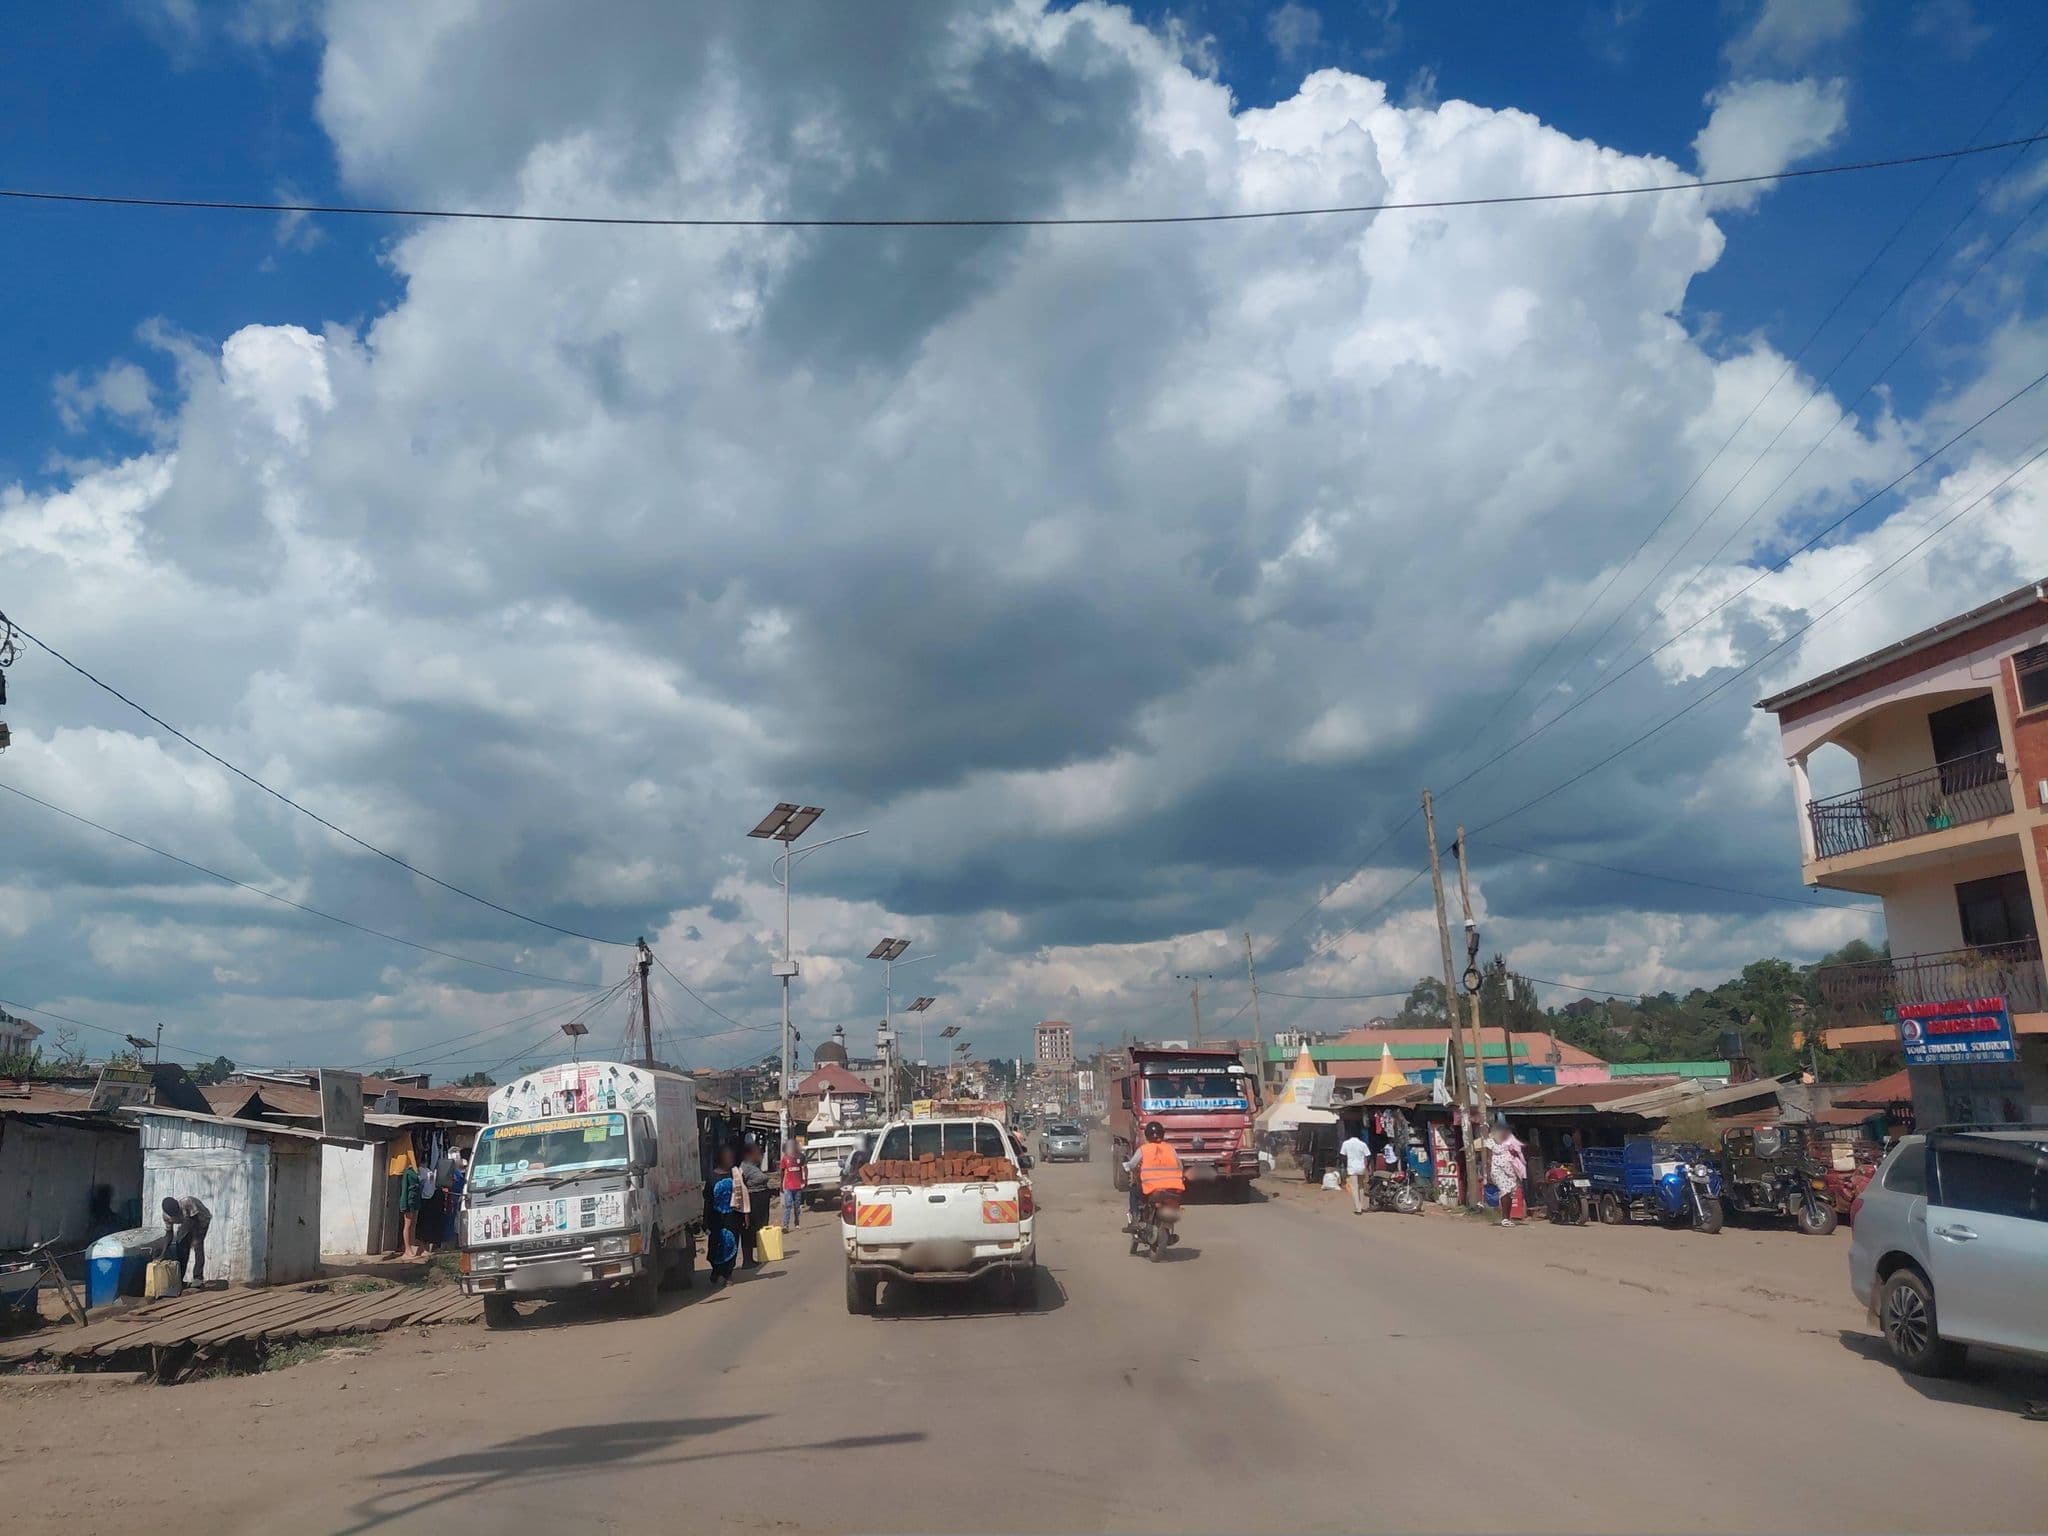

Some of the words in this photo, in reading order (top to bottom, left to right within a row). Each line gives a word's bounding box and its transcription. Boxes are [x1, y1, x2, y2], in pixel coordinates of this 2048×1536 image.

[1906, 1045, 1926, 1055] YOUR
[1927, 1043, 1968, 1054] FINANCIAL
[1971, 1040, 2010, 1052] SOLUTION
[510, 1236, 586, 1252] CANTER
